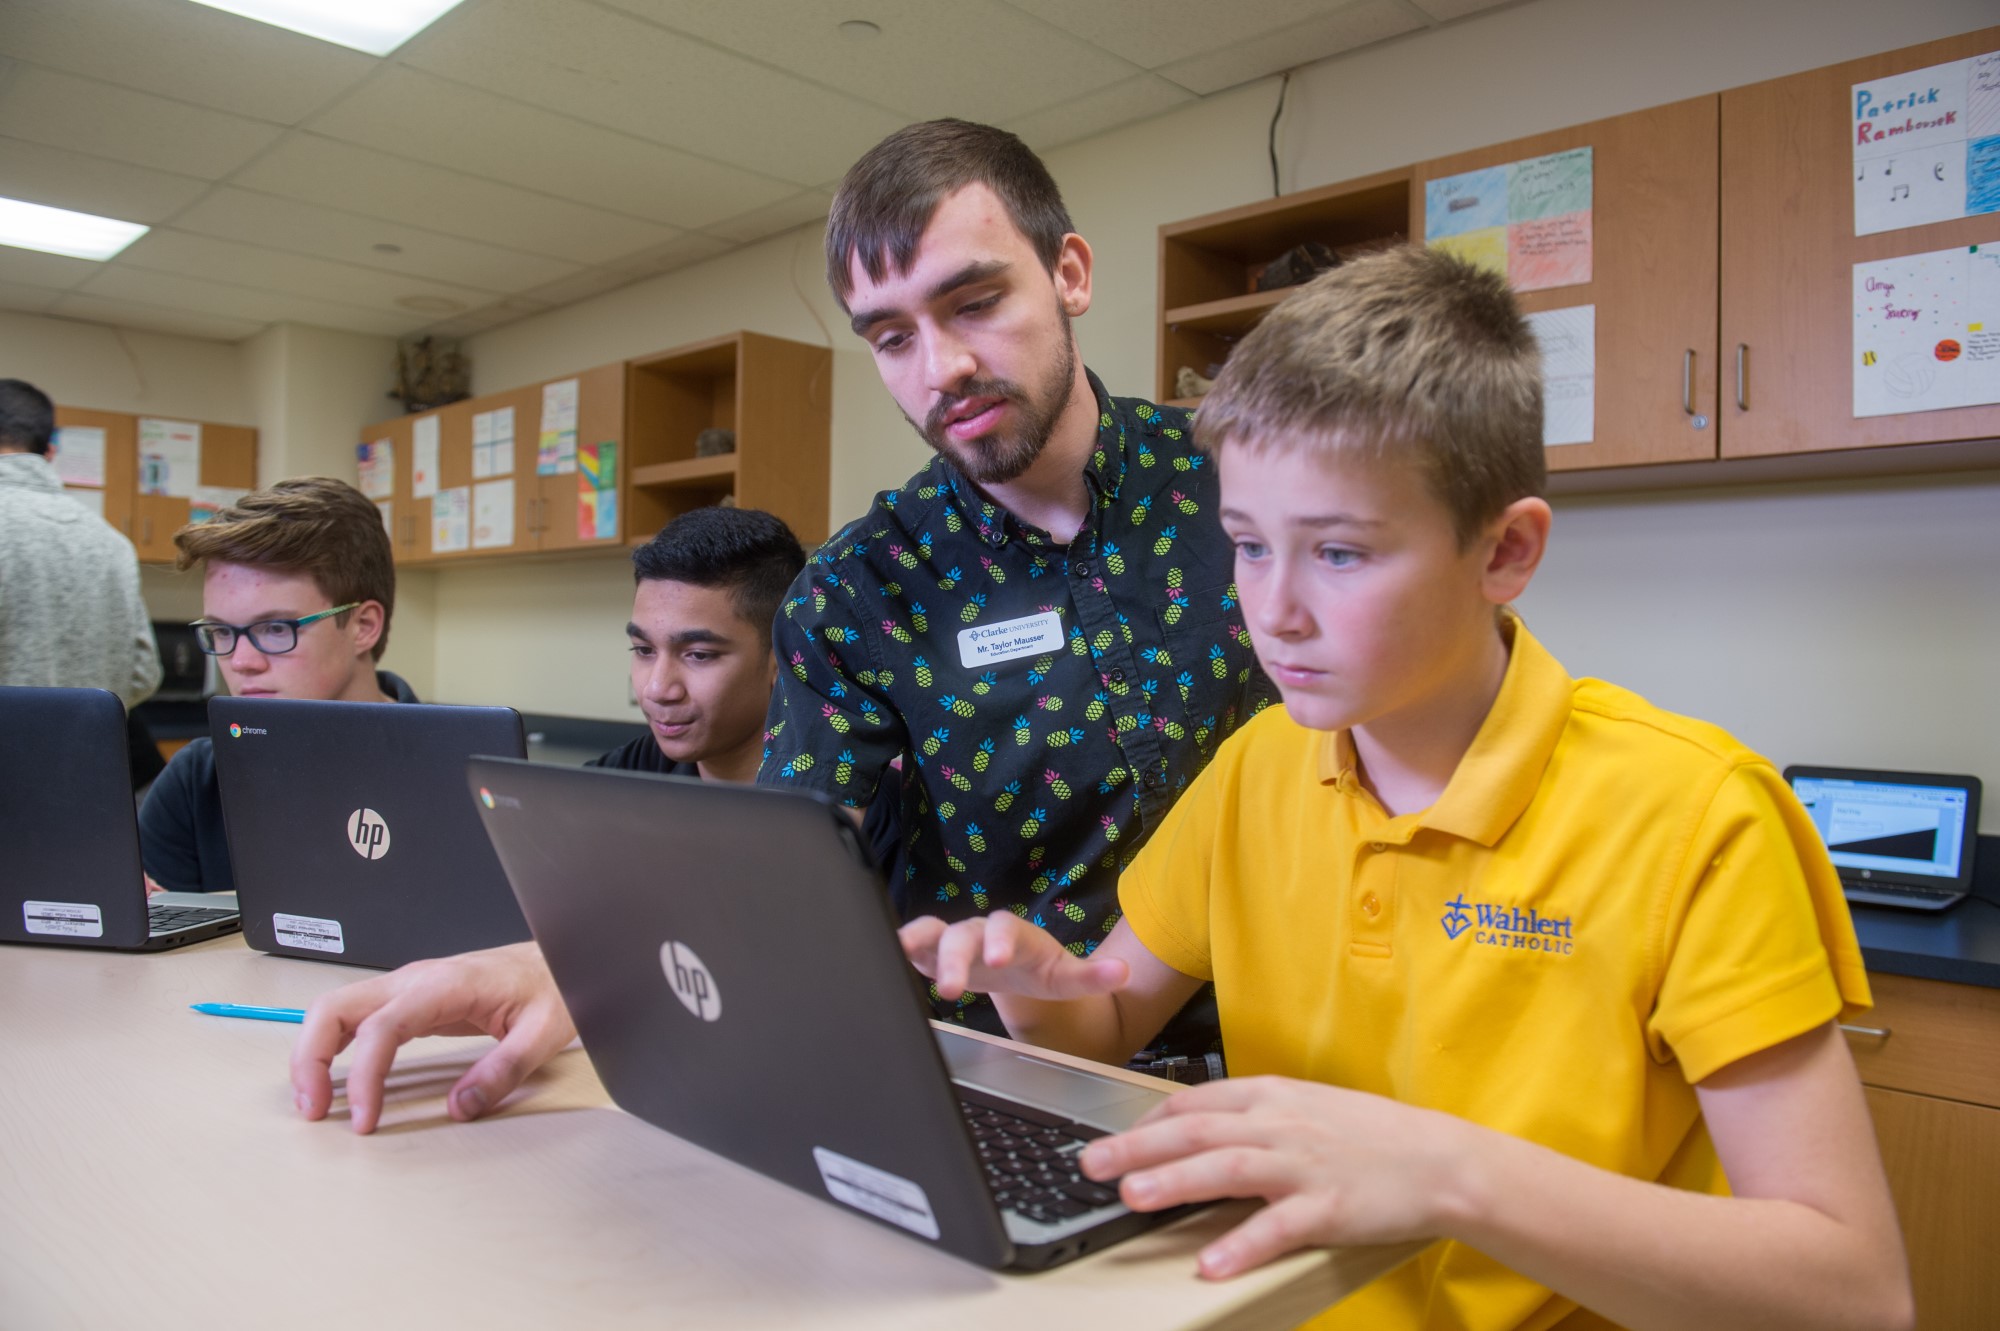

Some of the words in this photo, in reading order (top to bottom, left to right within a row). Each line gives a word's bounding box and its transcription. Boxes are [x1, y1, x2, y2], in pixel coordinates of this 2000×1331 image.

[981, 626, 1008, 638] Clarke
[1009, 619, 1049, 632] UNIVERSITY
[977, 646, 990, 654] Mr.
[991, 640, 1012, 652] Taylor
[1014, 634, 1044, 645] Mausser
[990, 649, 1010, 657] Education
[242, 726, 267, 735] chrome
[351, 808, 388, 860] hp
[1475, 904, 1573, 939] Wahlert
[1476, 931, 1573, 955] CATHOLIC
[665, 941, 715, 1020] hp
